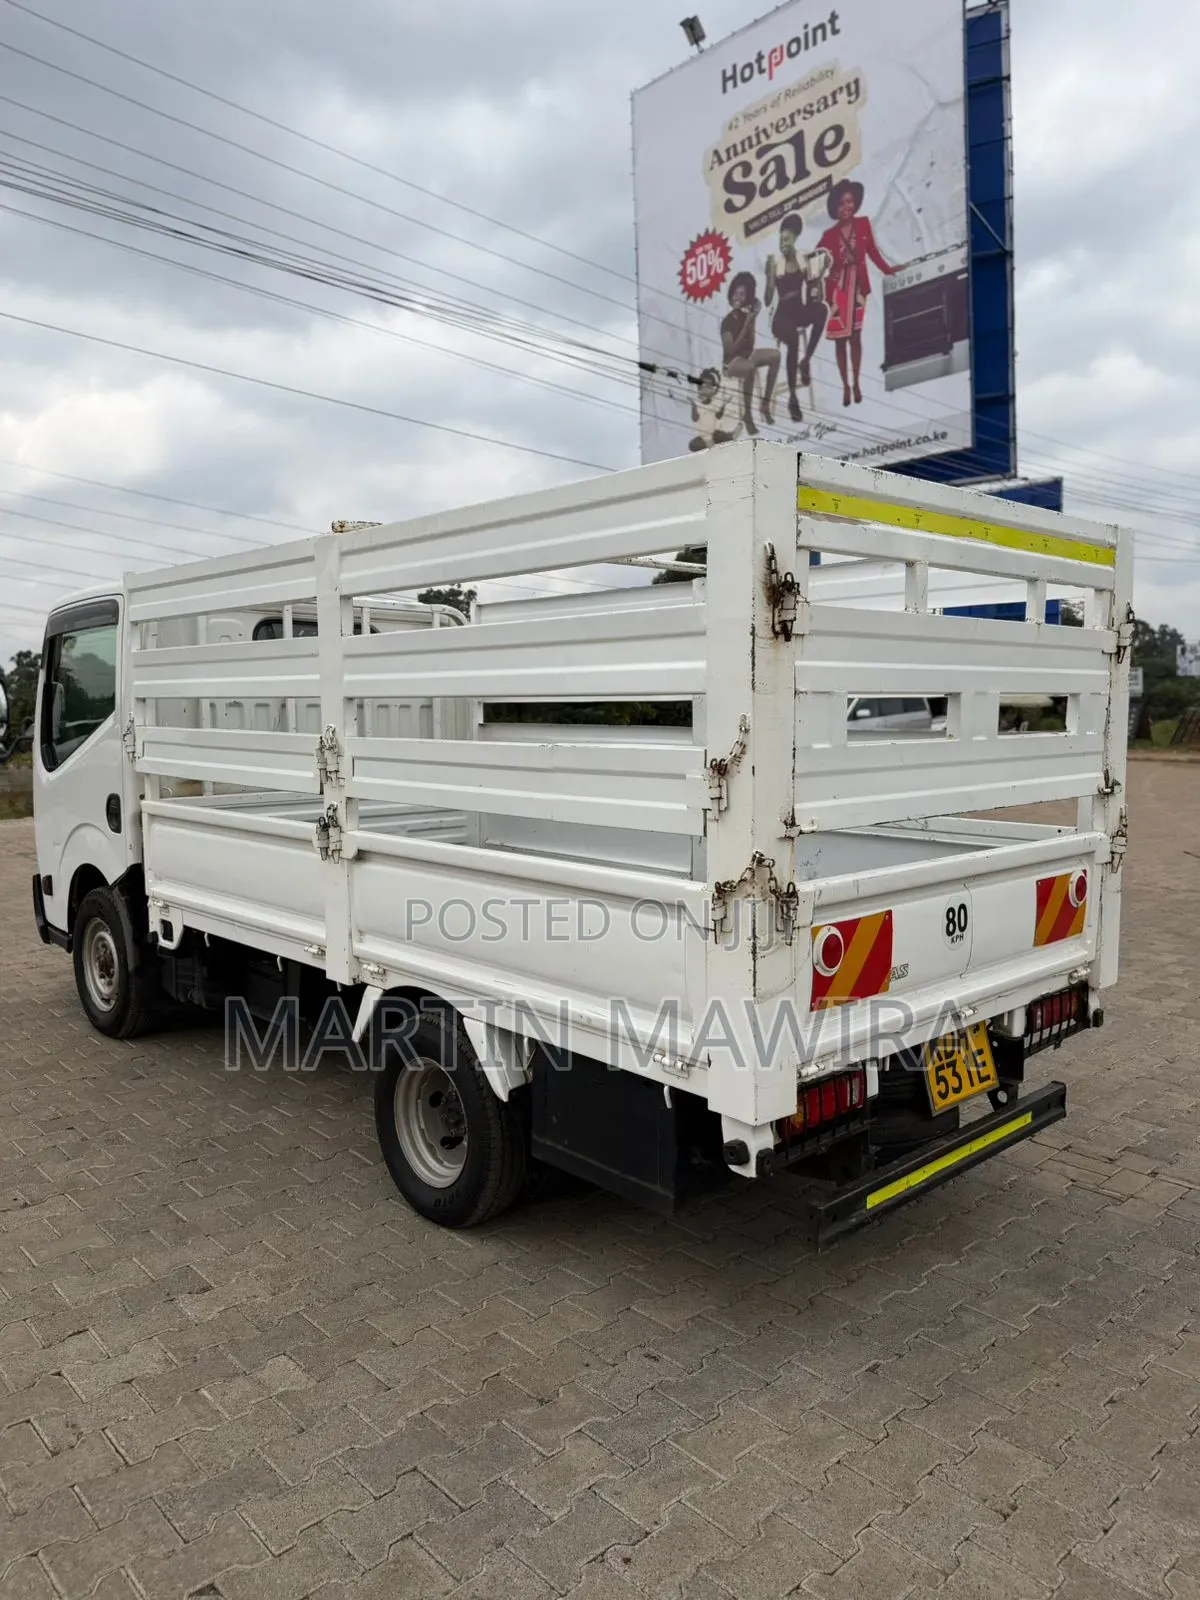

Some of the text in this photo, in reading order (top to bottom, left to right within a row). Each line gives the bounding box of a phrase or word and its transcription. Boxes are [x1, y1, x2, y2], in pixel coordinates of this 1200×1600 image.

[721, 9, 841, 95] Hotpoint
[709, 77, 860, 171] Anniversary
[686, 246, 724, 285] 50%
[945, 903, 968, 937] 80
[950, 933, 964, 944] KPH
[935, 1048, 991, 1100] 531E
